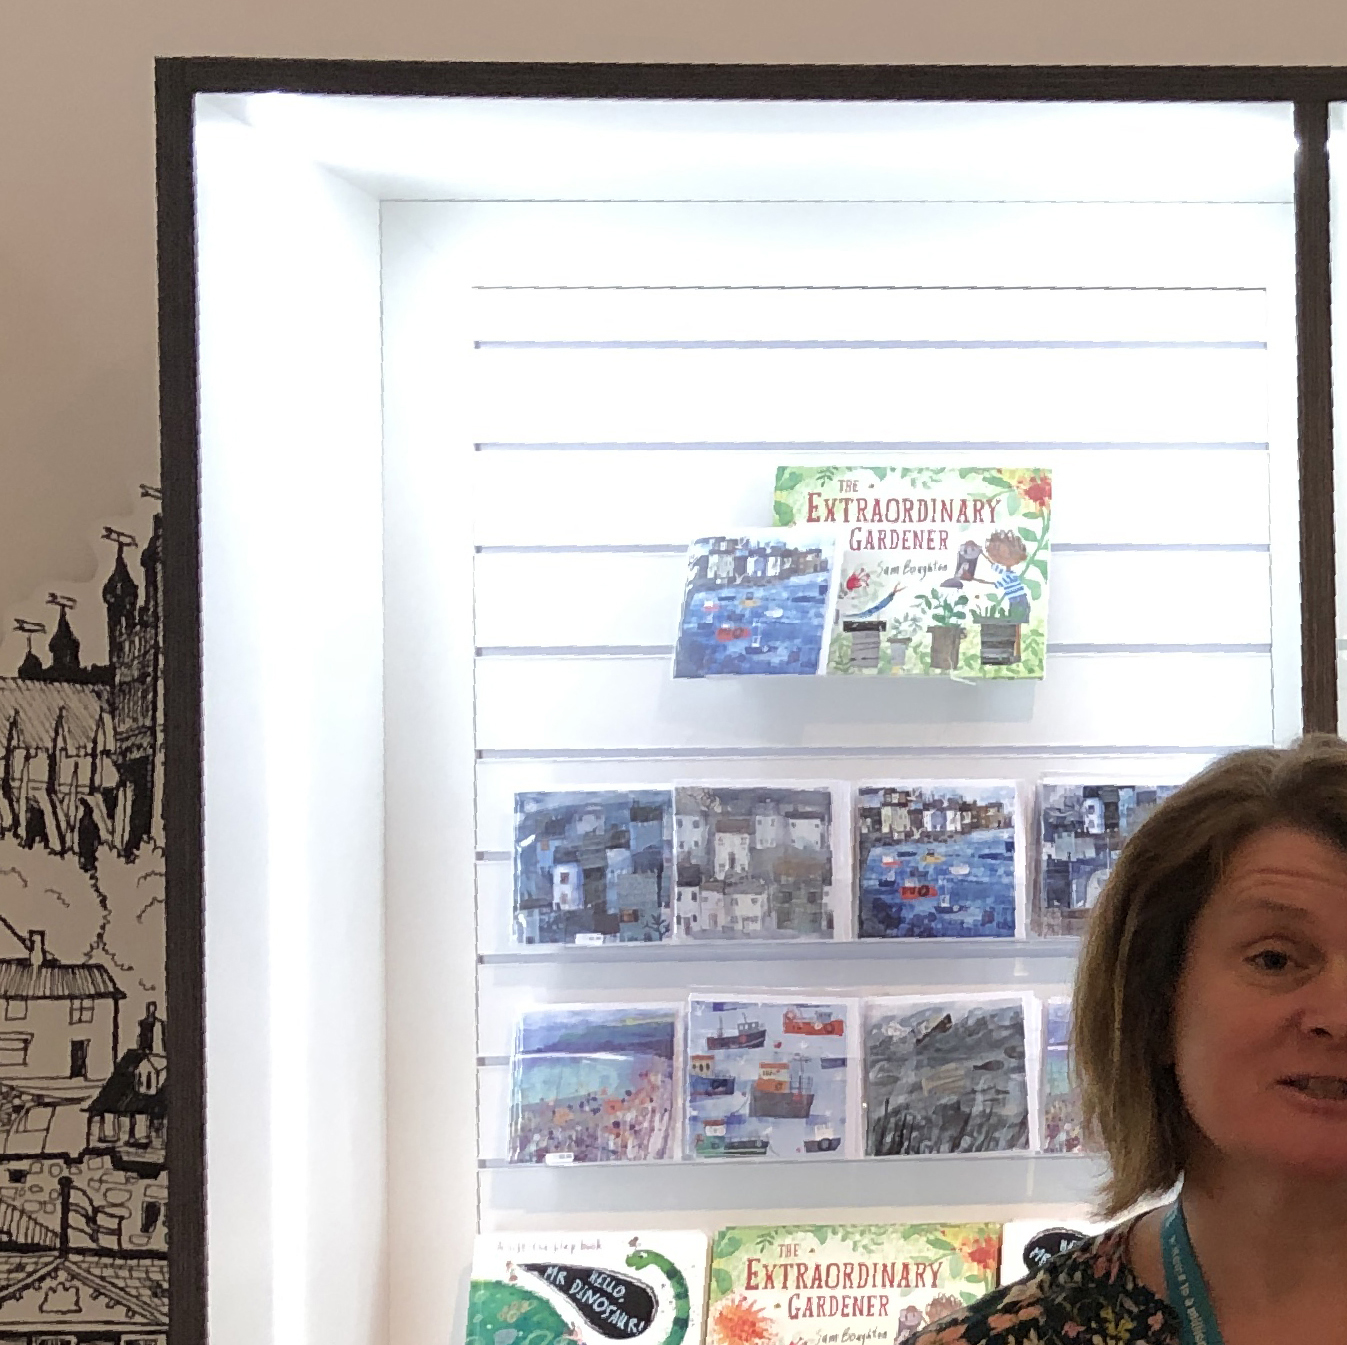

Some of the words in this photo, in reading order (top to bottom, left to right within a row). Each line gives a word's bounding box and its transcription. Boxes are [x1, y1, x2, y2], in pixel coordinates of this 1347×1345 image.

[838, 480, 859, 493] THE
[806, 492, 1002, 523] EXTRAORDINARY
[849, 527, 949, 551] GARDENER
[877, 561, 900, 576] Sam
[902, 559, 948, 581] Boughton
[778, 1244, 800, 1258] THE
[744, 1257, 944, 1291] EXTRAORDINARY
[544, 1266, 568, 1285] MR
[569, 1279, 645, 1335] DINOSAUR!
[788, 1293, 889, 1320] GARDENER
